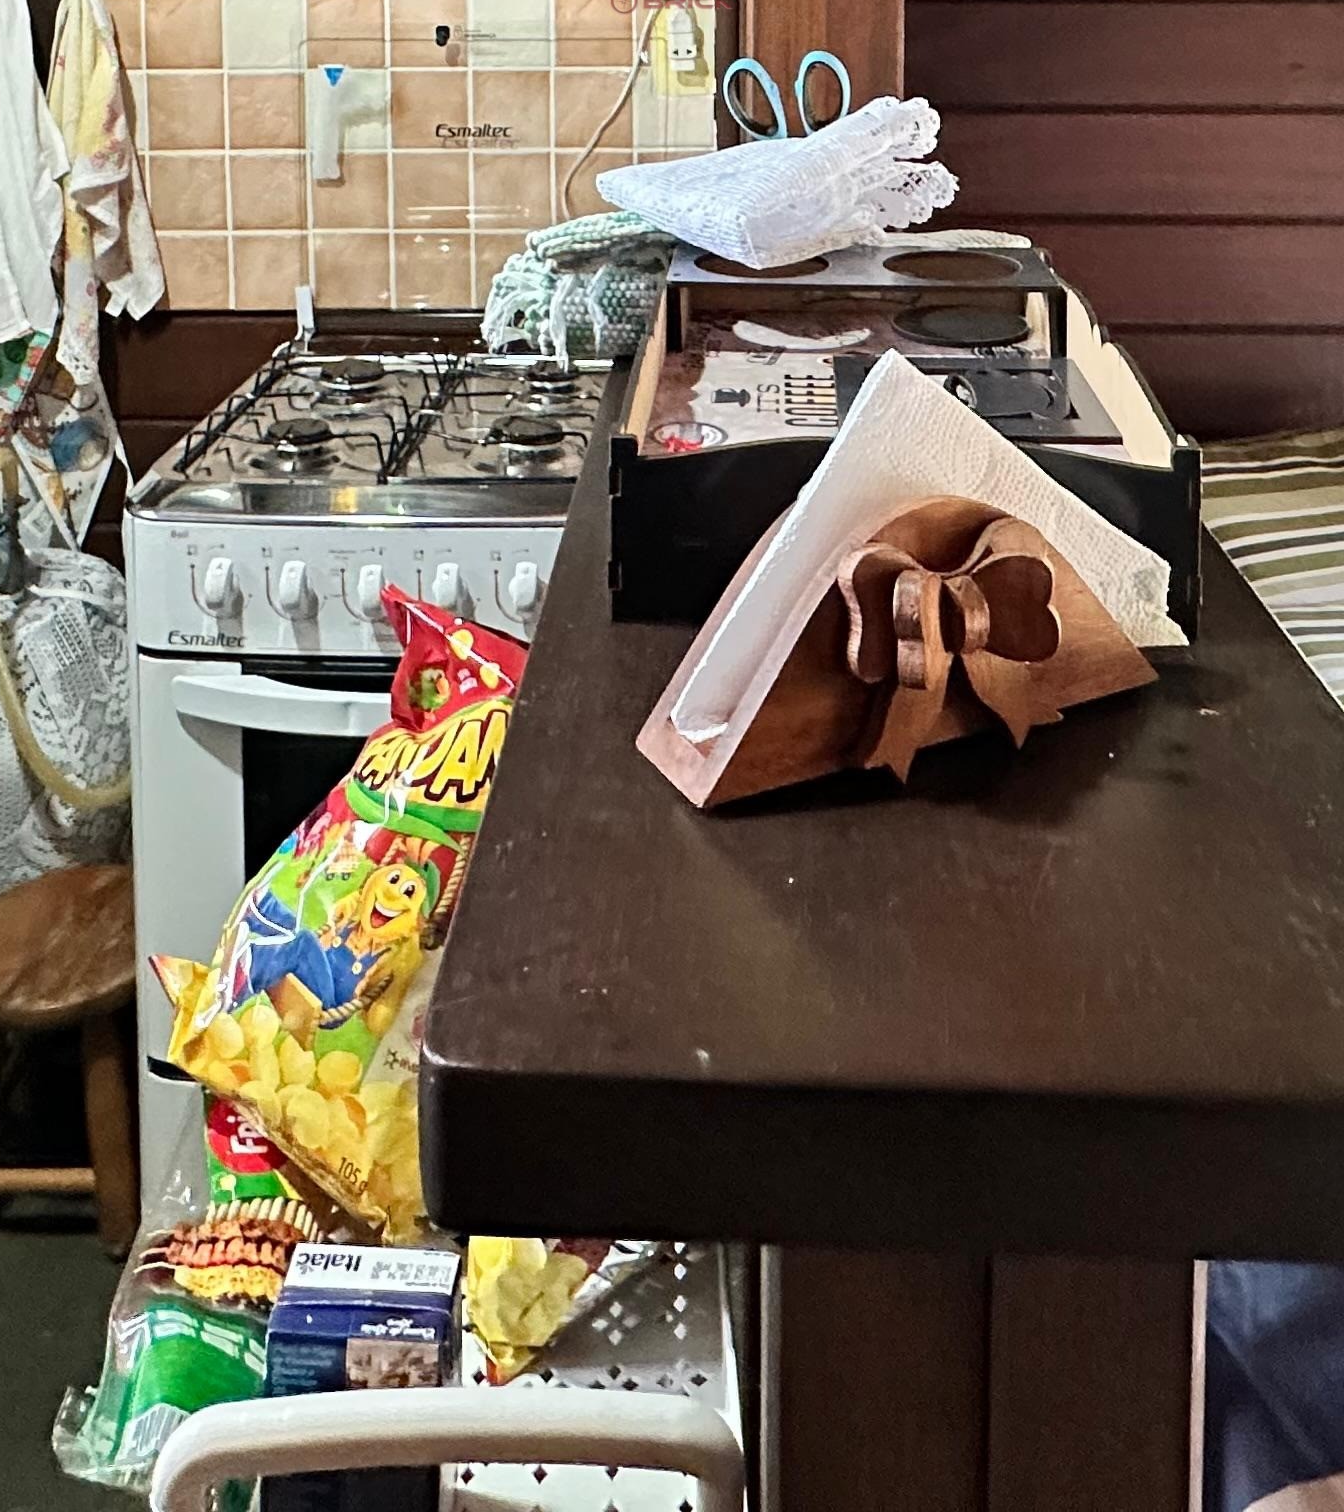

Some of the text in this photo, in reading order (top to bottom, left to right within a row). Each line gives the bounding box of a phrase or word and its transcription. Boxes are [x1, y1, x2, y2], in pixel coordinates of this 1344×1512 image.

[435, 123, 513, 138] Esmaltec
[757, 384, 780, 414] ITS
[784, 374, 839, 427] COFFEE
[168, 630, 246, 648] Esmaltec
[338, 1157, 363, 1186] 105
[297, 1253, 362, 1272] Italac
